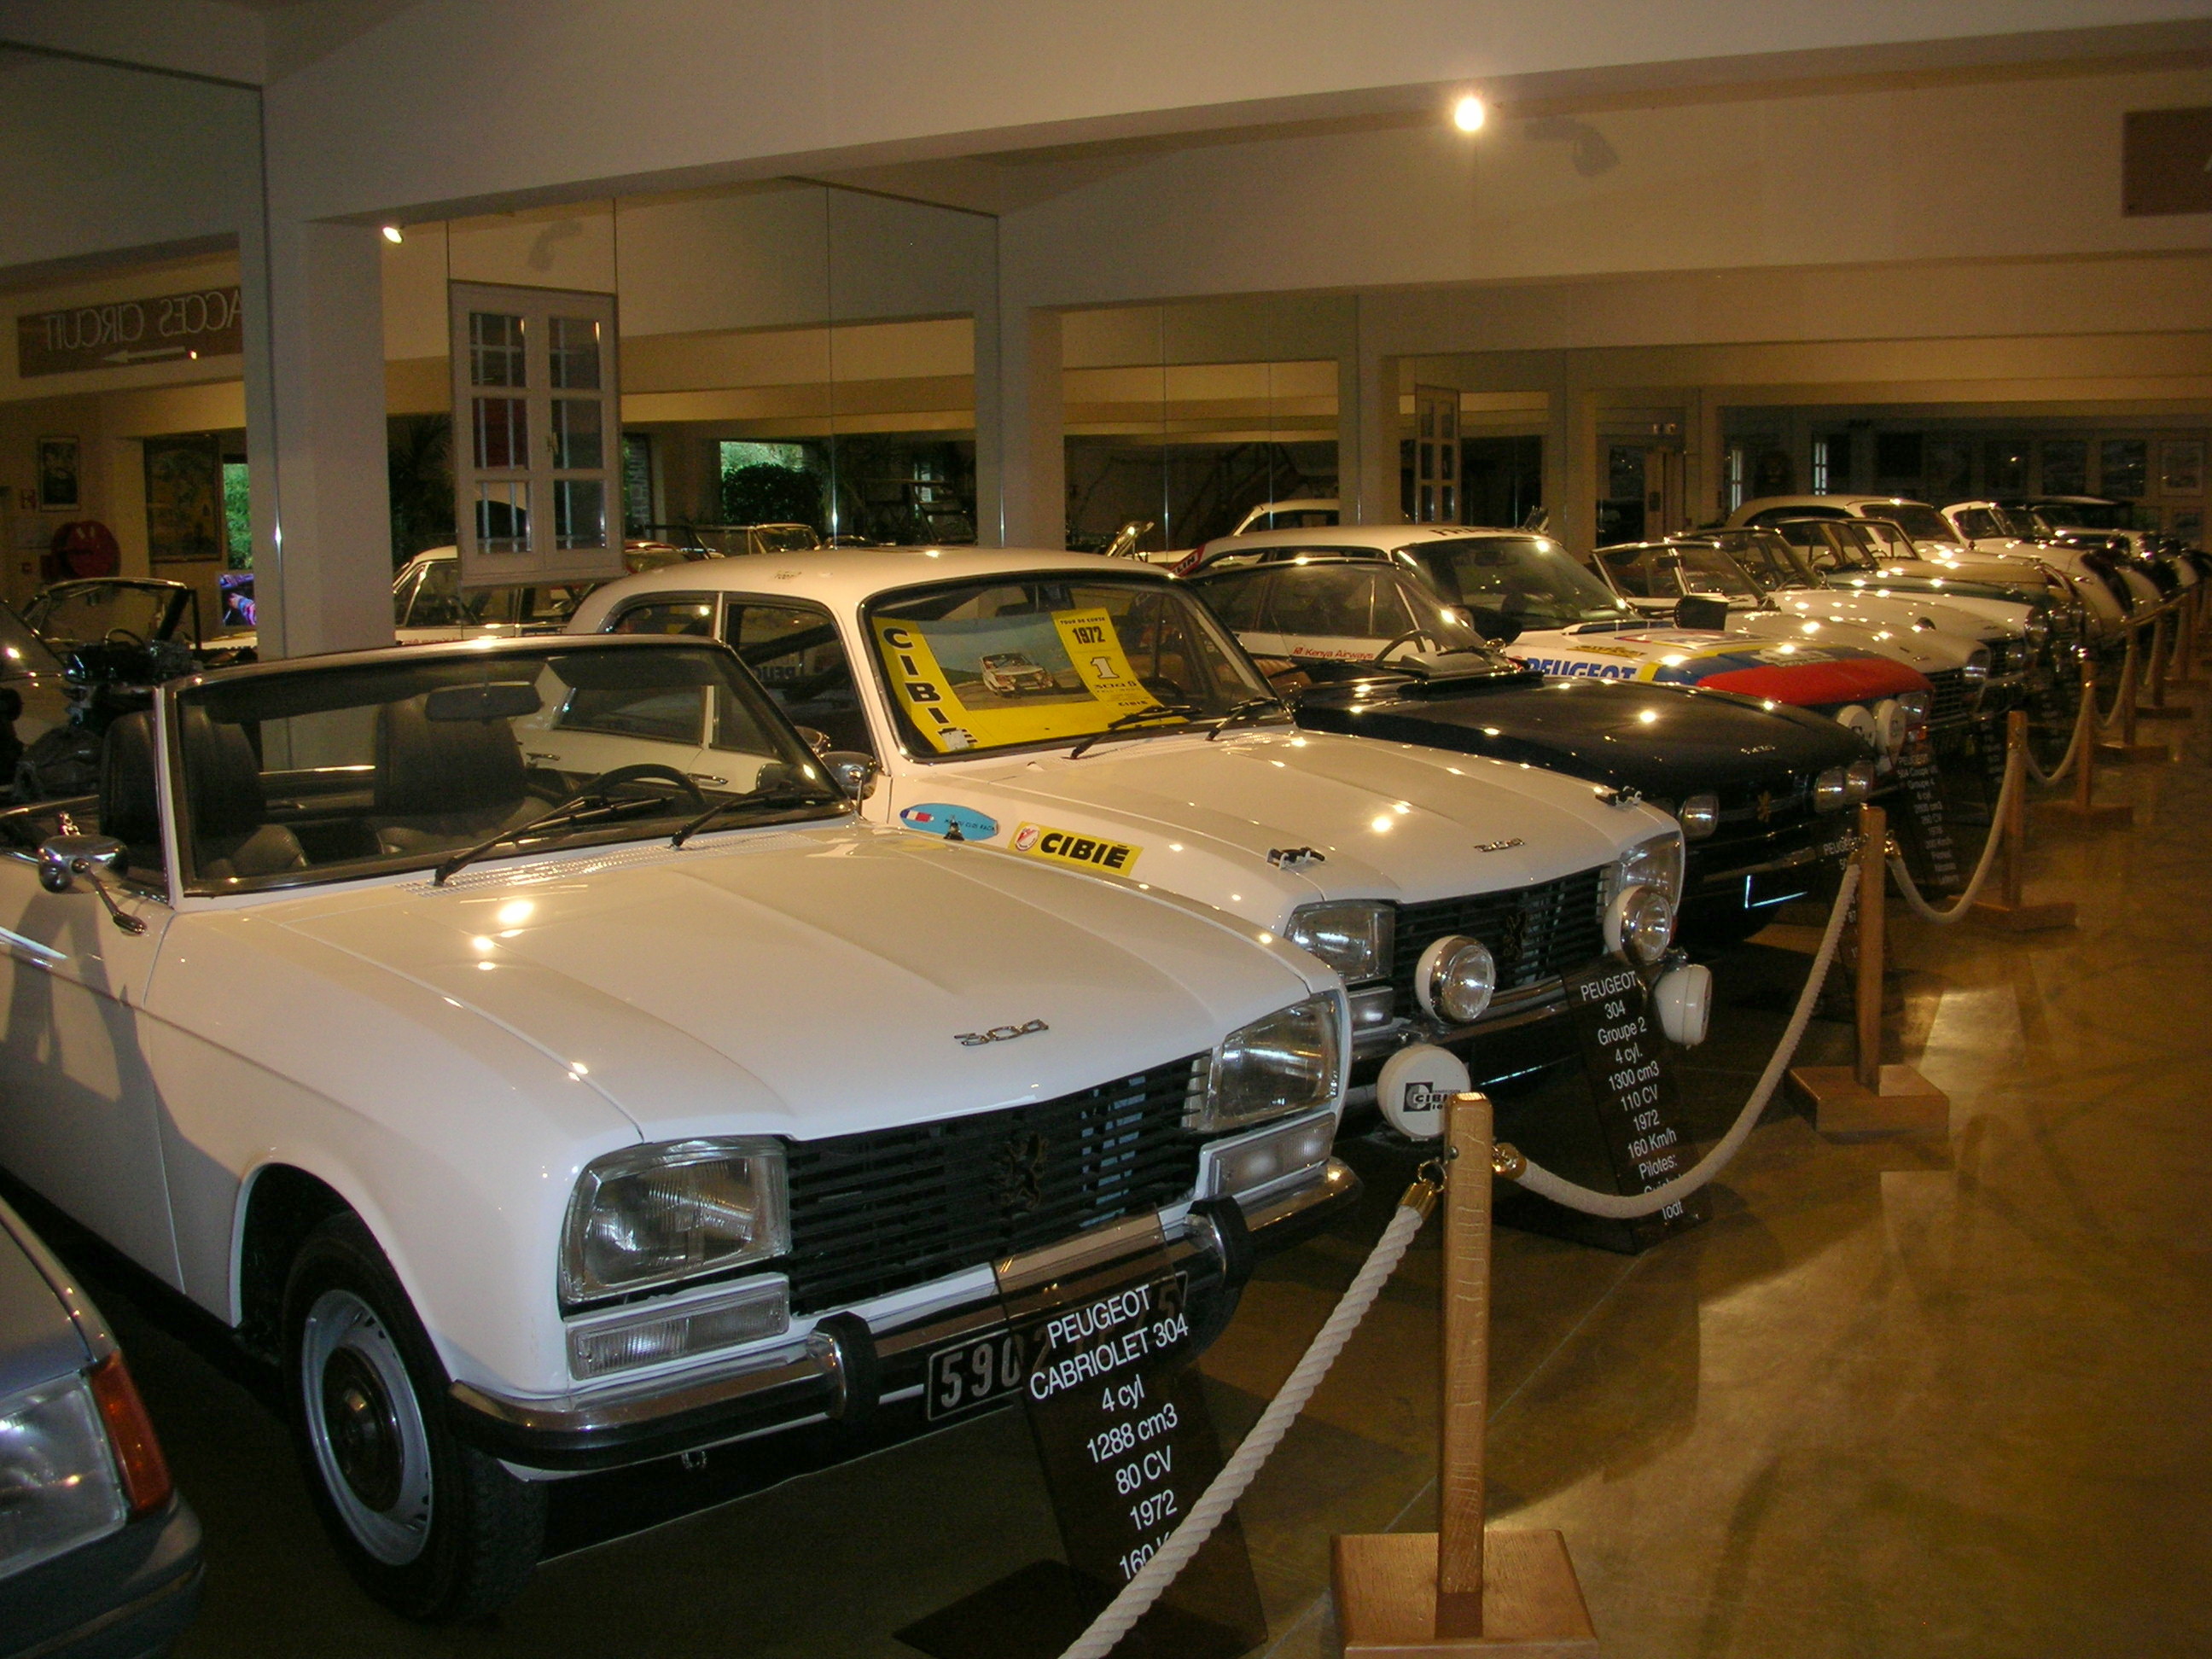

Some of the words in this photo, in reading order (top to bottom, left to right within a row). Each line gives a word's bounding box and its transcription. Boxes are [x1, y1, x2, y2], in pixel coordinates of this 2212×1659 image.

[1073, 626, 1106, 644] 1972
[1306, 649, 1333, 659] Kenya
[1336, 649, 1375, 661] Airways
[1527, 657, 1638, 680] PEUGEOT
[1580, 970, 1637, 1002] PEUGEOT
[1604, 1000, 1626, 1020] 304
[953, 1018, 1050, 1046] 304
[1598, 1022, 1638, 1045] Groupe
[1638, 1016, 1648, 1033] 2
[1615, 1048, 1623, 1064] 4
[1624, 1042, 1644, 1064] cyl.
[1609, 1068, 1635, 1091] 1300
[1637, 1060, 1660, 1081] cm3
[1415, 1093, 1448, 1103] CIBI
[1621, 1091, 1641, 1111] 110
[1642, 1084, 1659, 1103] CV
[1633, 1109, 1661, 1132] 1972
[1627, 1138, 1648, 1159] 160
[1649, 1127, 1678, 1151] Km/h
[1639, 1154, 1678, 1180] Pilotes:
[1047, 1284, 1150, 1349] PEUGEOT
[1030, 1326, 1149, 1400] CABRIOLET
[1152, 1313, 1189, 1349] 304
[1102, 1387, 1115, 1412] 4
[1118, 1373, 1145, 1410] cyl
[1086, 1423, 1136, 1464] 1288
[1138, 1402, 1179, 1441] cm3
[1115, 1463, 1142, 1494] 80
[1144, 1444, 1172, 1481] CV
[1130, 1488, 1178, 1530] 1972
[1119, 1544, 1154, 1580] 160
